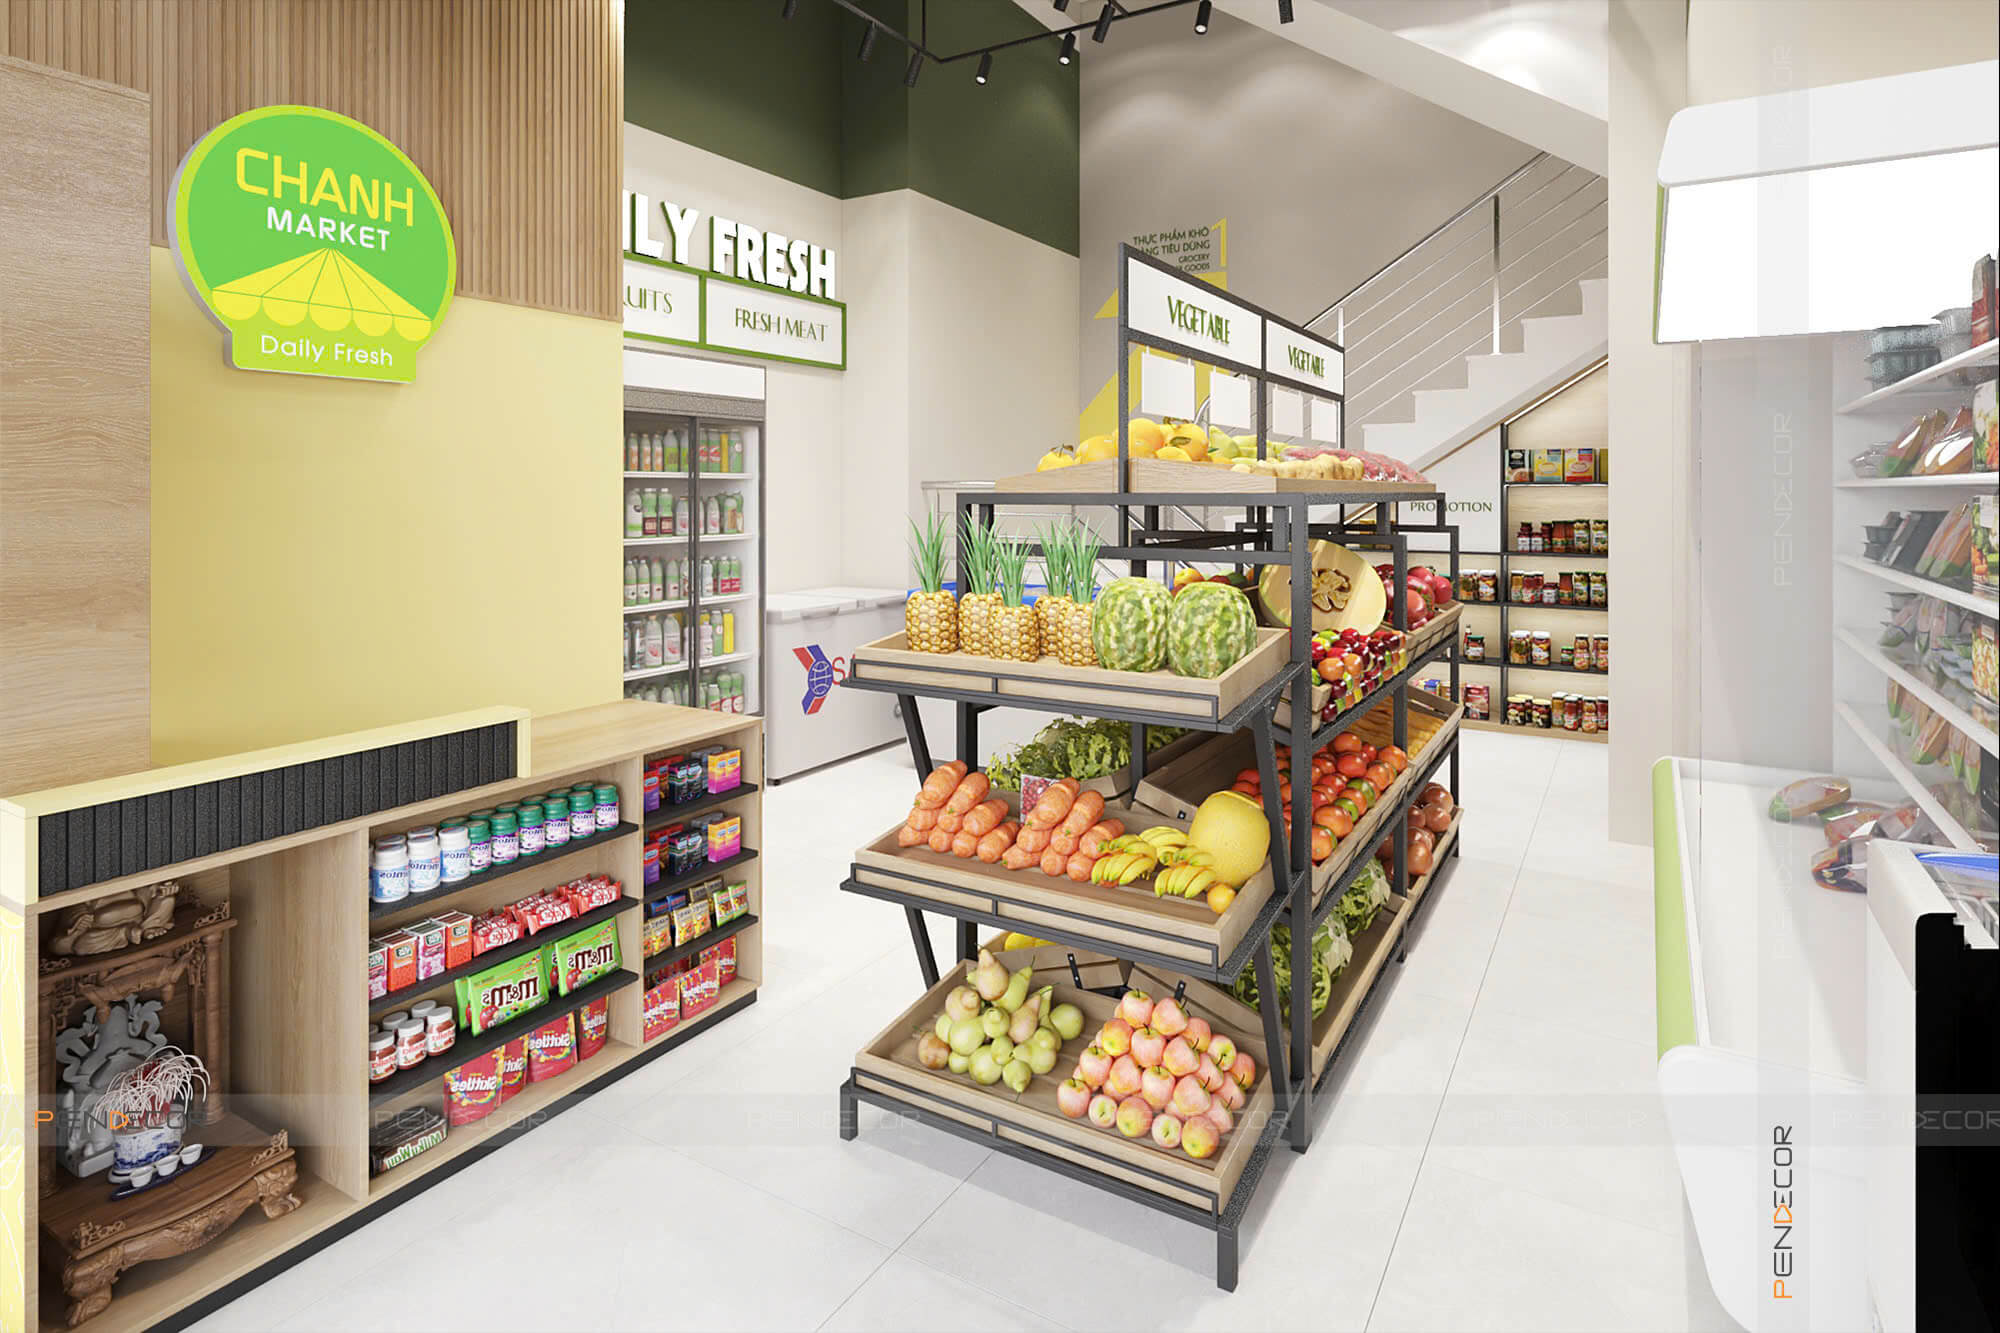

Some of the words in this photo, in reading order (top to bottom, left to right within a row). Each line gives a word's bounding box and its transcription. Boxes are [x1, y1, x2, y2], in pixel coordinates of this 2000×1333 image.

[235, 147, 414, 227] CHANH
[267, 206, 390, 252] MARKET
[709, 215, 836, 300] FRESH
[623, 284, 673, 314] UITS
[735, 307, 781, 335] FRESH
[785, 317, 829, 342] MEAT
[1167, 295, 1231, 345] VEGETABLE
[260, 334, 326, 364] Daily
[333, 340, 394, 367] Fresh
[1287, 344, 1325, 378] VEGETABLE
[1409, 501, 1493, 513] PROOTION
[831, 654, 856, 686] S
